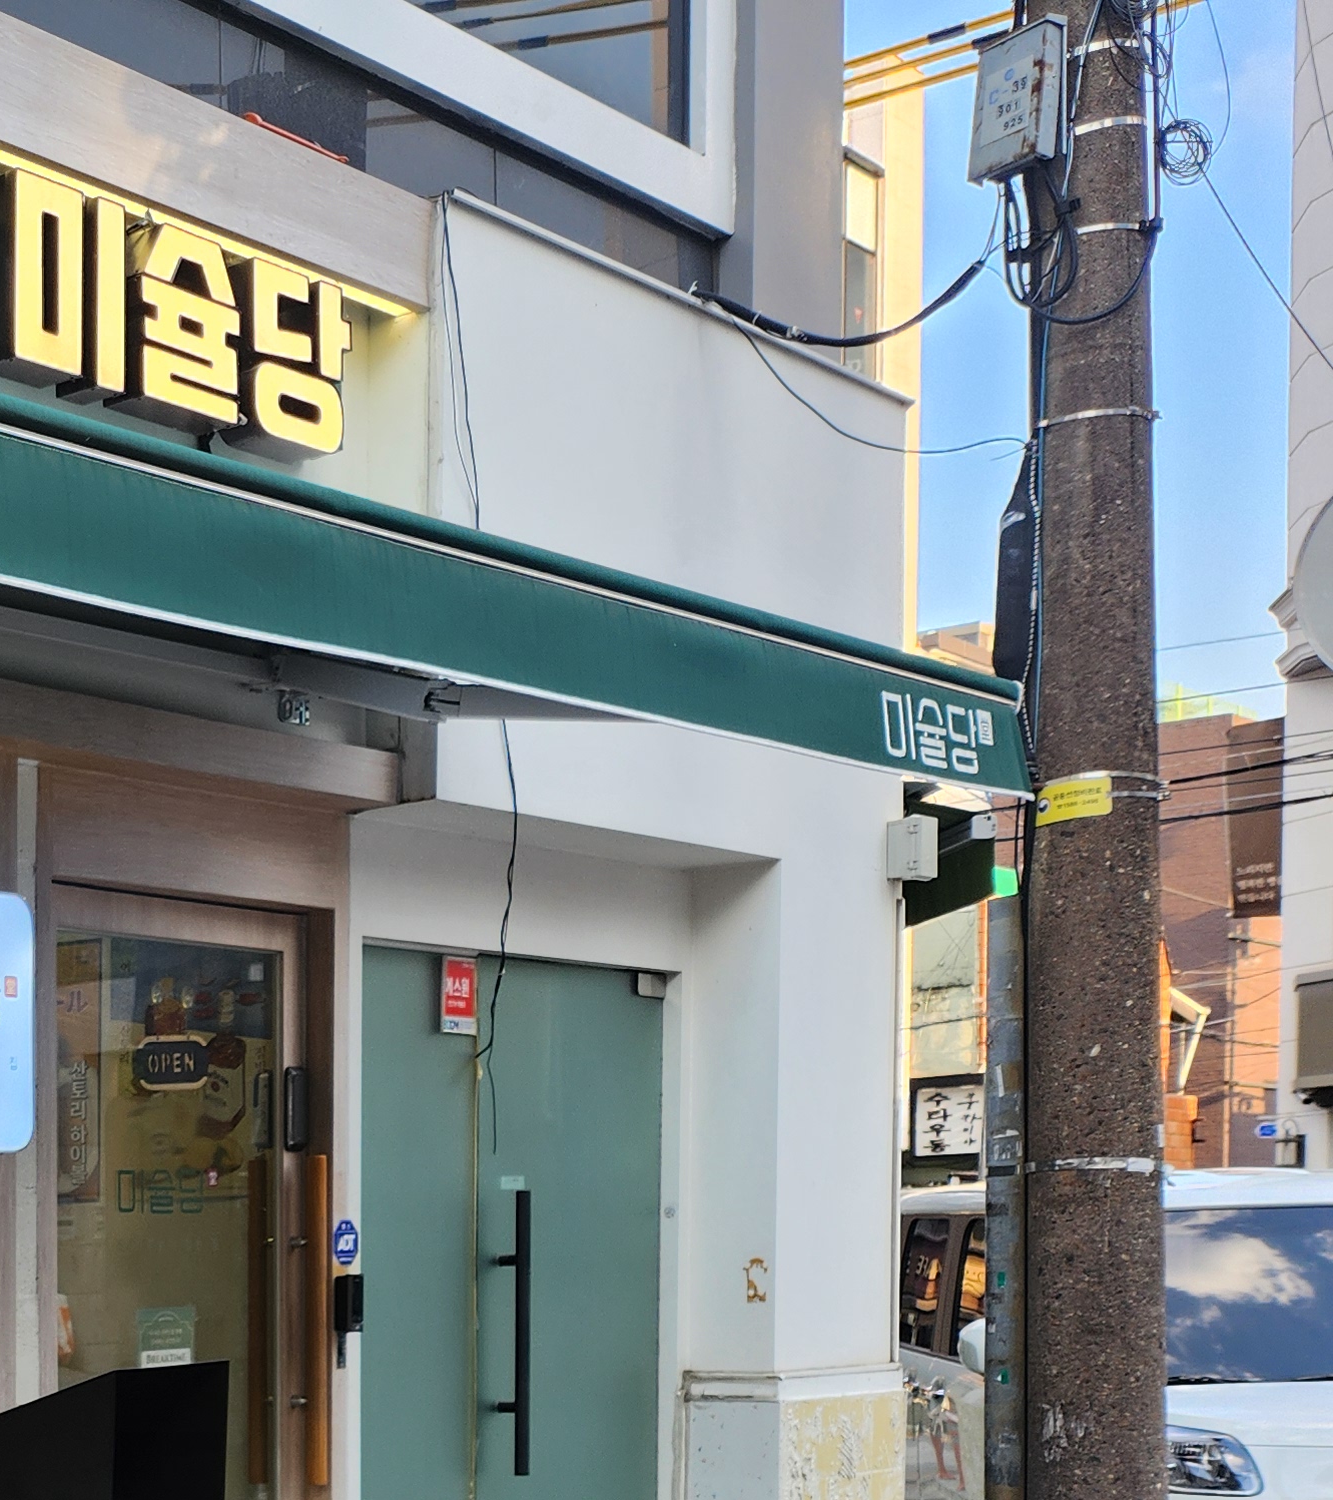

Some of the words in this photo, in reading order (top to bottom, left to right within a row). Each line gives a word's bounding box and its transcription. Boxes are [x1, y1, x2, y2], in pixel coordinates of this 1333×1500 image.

[1003, 114, 1024, 131] 925
[13, 168, 352, 454] 미슐당
[880, 690, 980, 775] 미슐당
[147, 1053, 196, 1074] OPEN
[70, 1060, 89, 1120] 산토리
[337, 1233, 357, 1252] ADT
